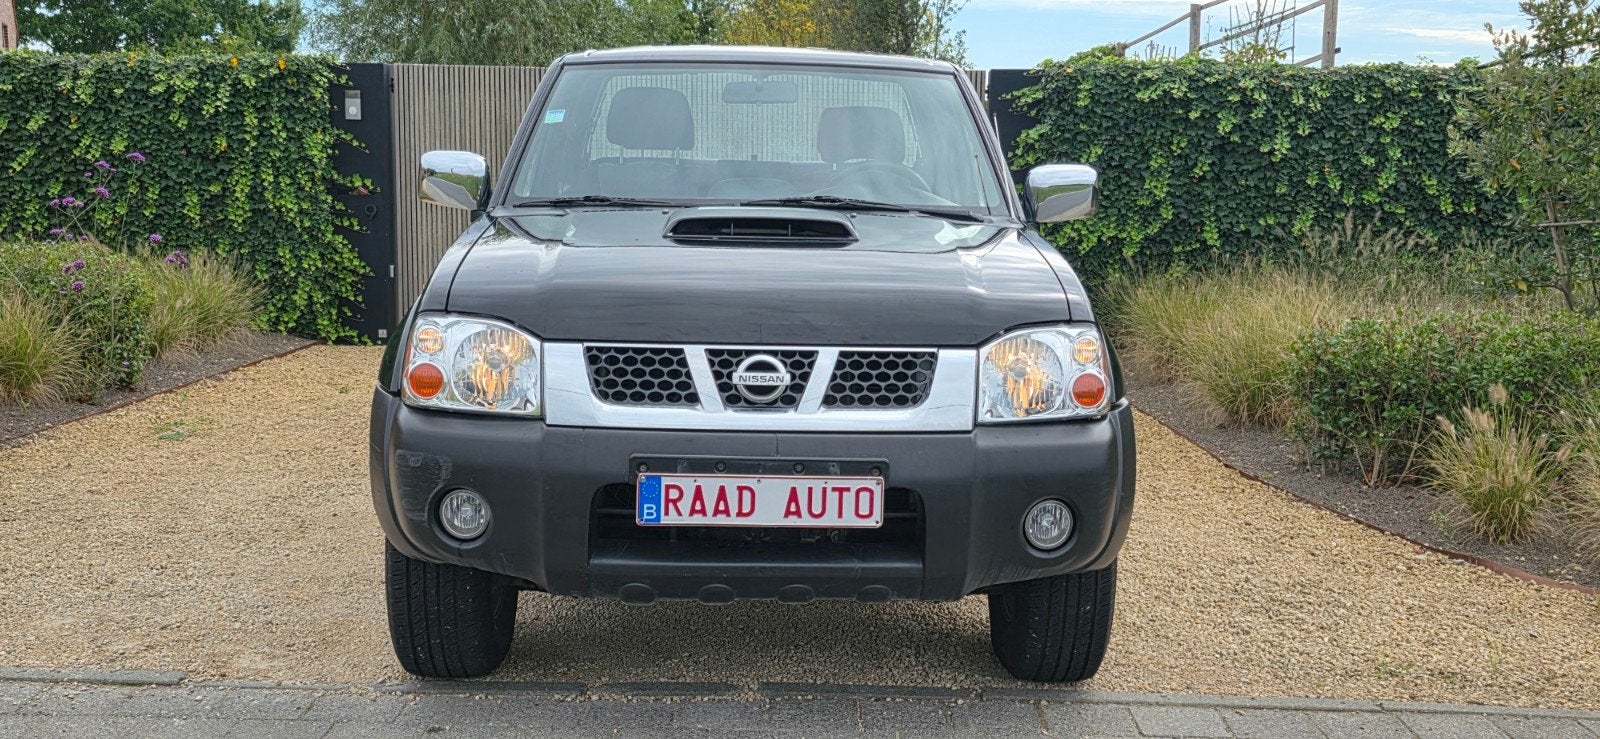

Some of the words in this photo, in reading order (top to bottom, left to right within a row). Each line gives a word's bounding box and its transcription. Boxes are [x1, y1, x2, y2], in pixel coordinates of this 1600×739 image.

[365, 204, 377, 220] 9
[738, 375, 785, 383] NISSAN
[643, 503, 657, 519] B
[663, 483, 756, 518] RAAD
[783, 486, 875, 519] AUTO
